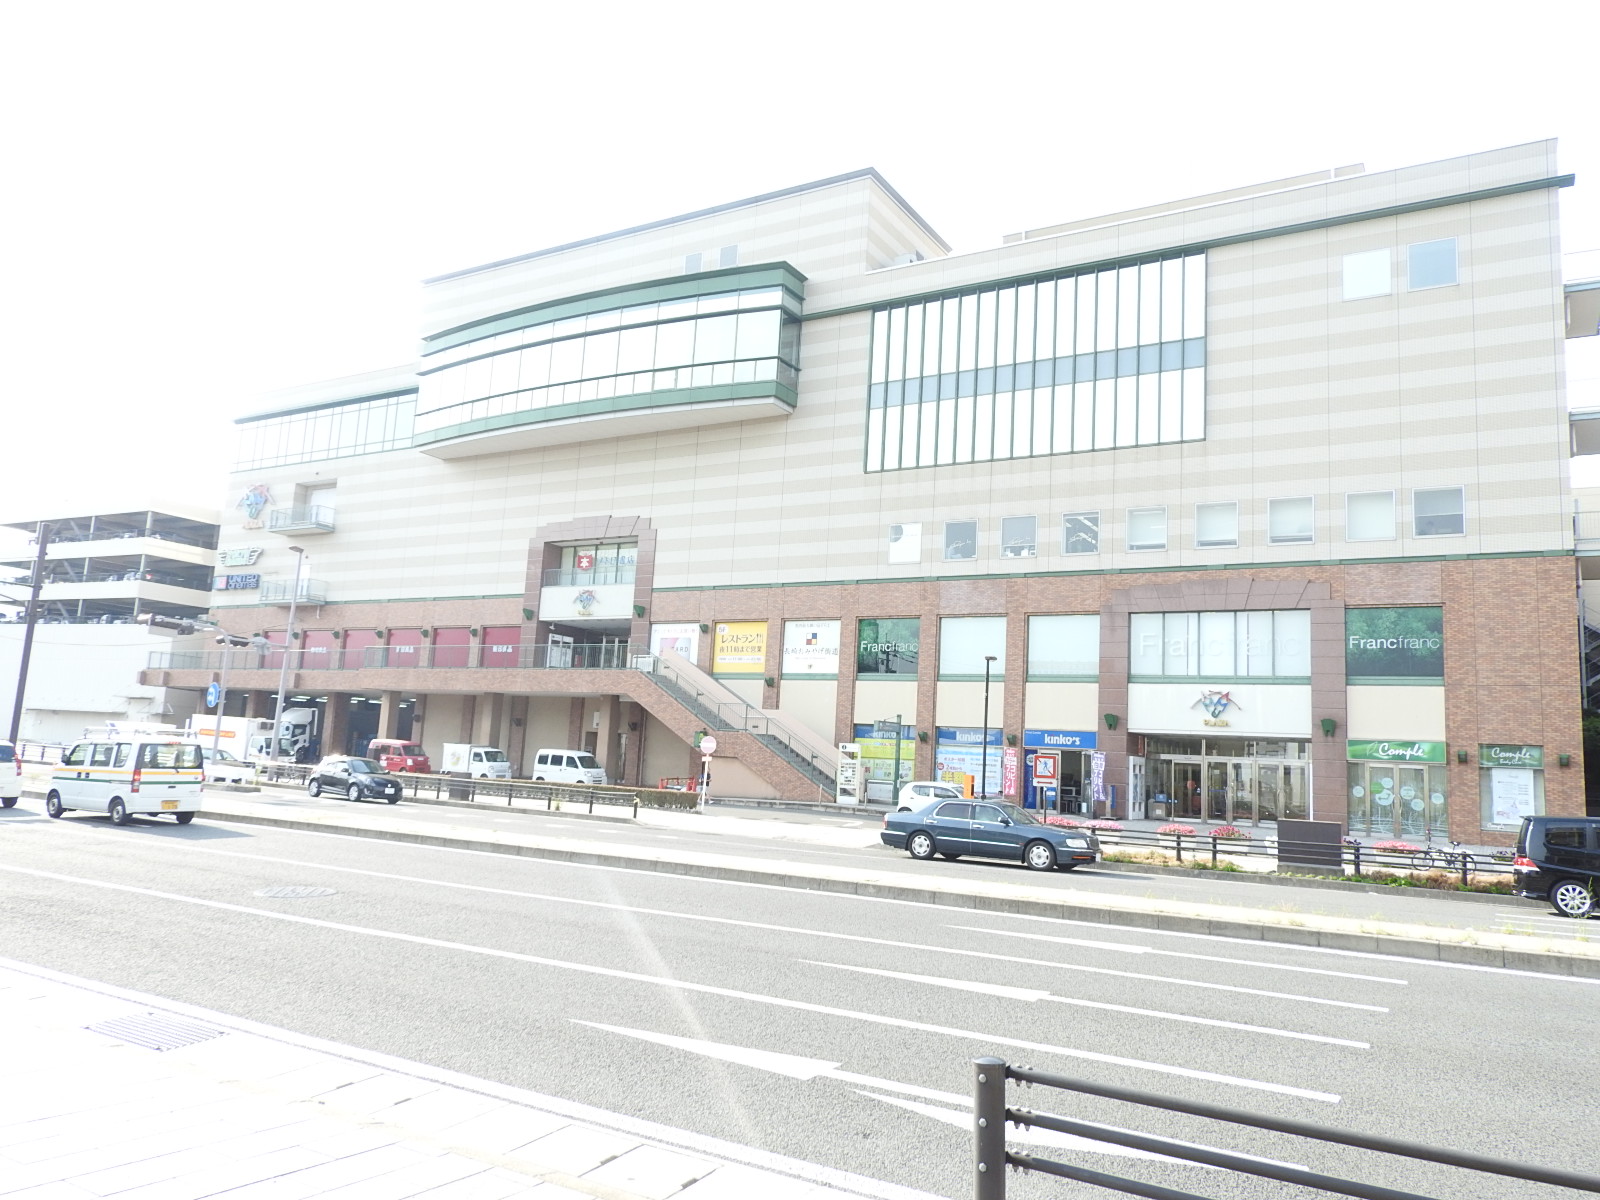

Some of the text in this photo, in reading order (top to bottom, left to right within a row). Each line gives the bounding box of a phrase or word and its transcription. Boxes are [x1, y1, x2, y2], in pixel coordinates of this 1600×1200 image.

[580, 557, 590, 568] 本
[229, 574, 257, 583] UNITED
[721, 634, 756, 644] レストラン
[1349, 635, 1440, 649] Francfranc
[860, 640, 919, 652] Francfranc
[1044, 733, 1081, 745] kinko's
[1378, 743, 1424, 760] Comple
[1491, 747, 1531, 760] Comple
